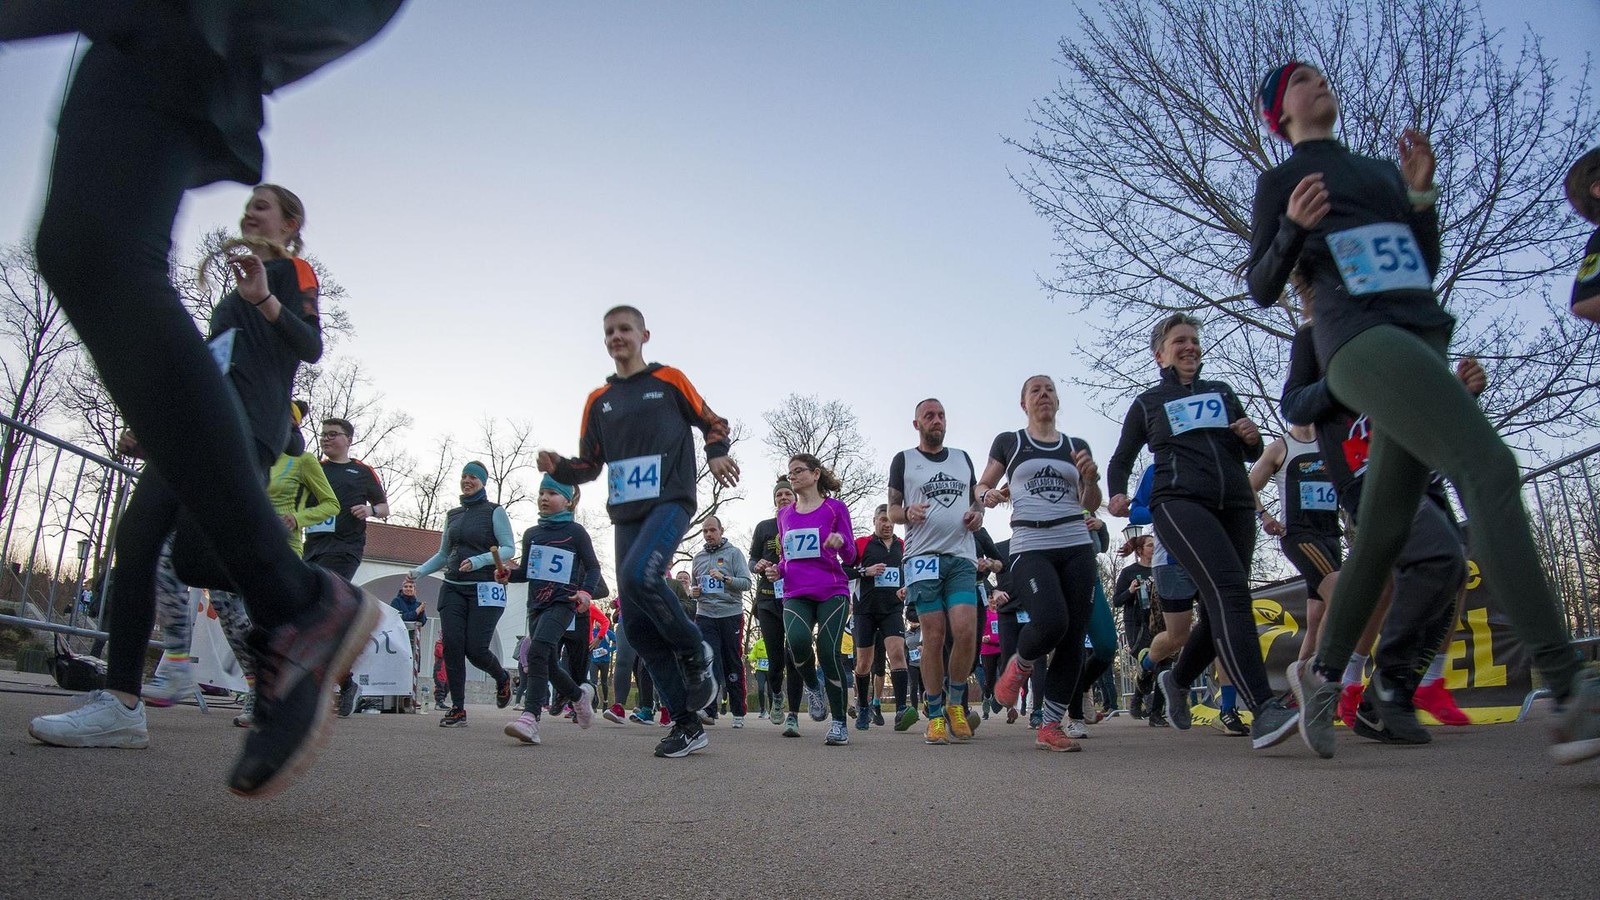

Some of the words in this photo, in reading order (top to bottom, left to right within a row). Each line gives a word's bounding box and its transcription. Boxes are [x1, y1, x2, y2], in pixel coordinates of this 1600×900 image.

[1373, 235, 1419, 272] 55
[1188, 399, 1222, 420] 79
[627, 463, 658, 489] 44
[1316, 487, 1335, 503] 16
[795, 534, 818, 551] 72
[549, 554, 564, 573] 5
[915, 559, 937, 575] 94
[709, 578, 723, 589] 81
[885, 571, 898, 582] 49
[491, 586, 507, 600] 82
